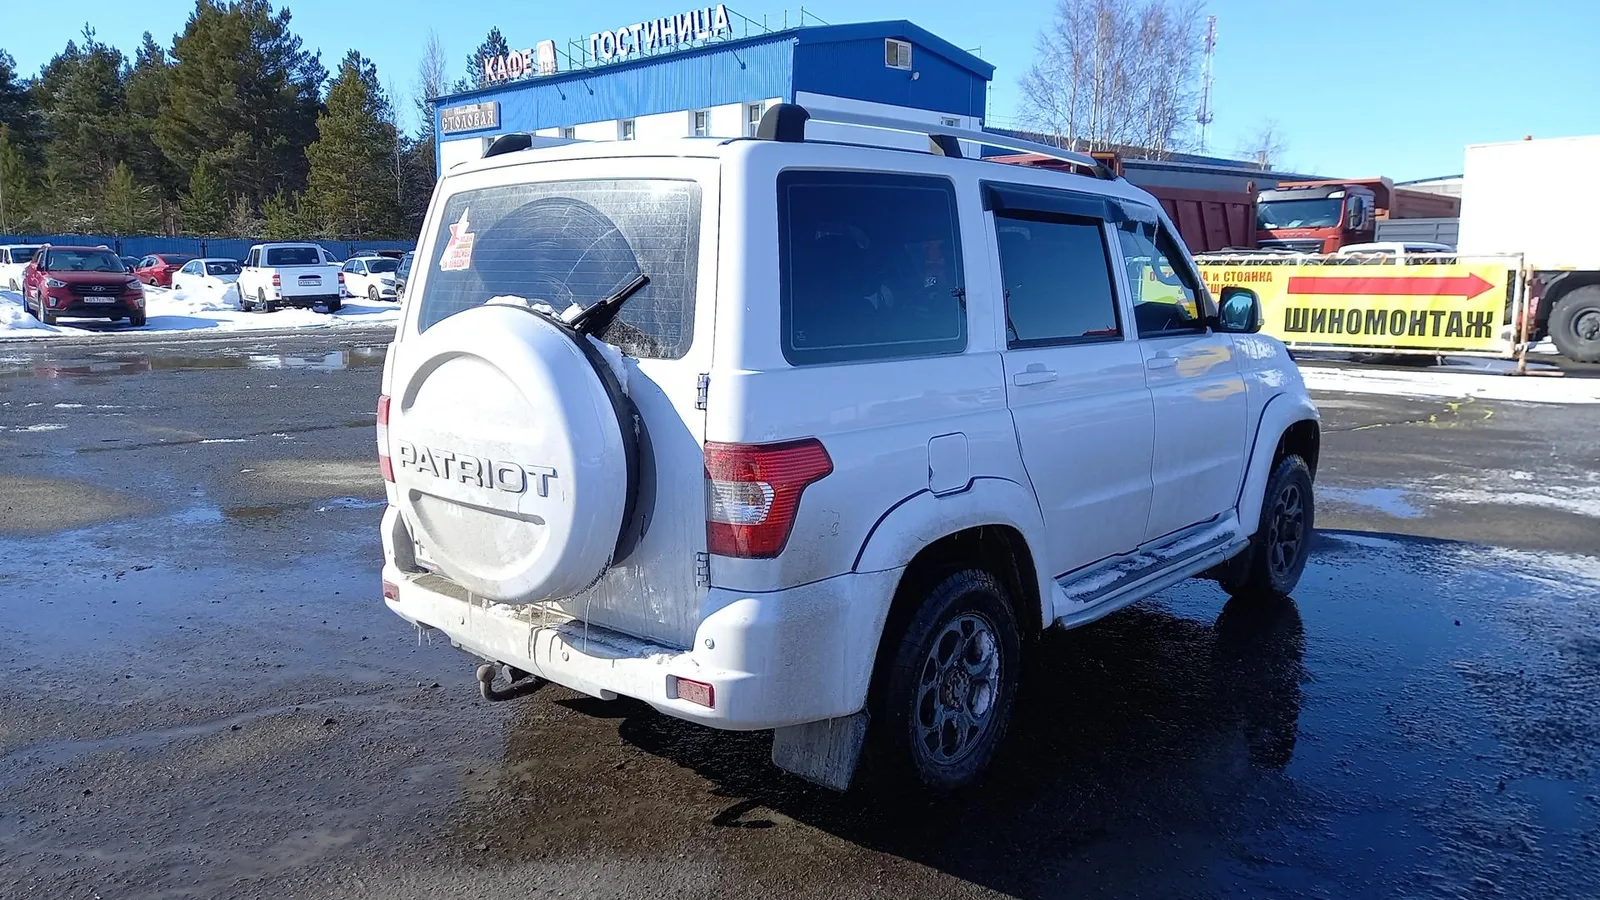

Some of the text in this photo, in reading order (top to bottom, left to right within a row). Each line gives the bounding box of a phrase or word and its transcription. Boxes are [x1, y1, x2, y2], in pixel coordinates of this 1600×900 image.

[590, 4, 732, 62] ГОСТИНИЦА
[484, 48, 534, 82] КАФЕ
[441, 110, 494, 131] СТОЛОВАЯ
[1223, 271, 1273, 283] СТОЯНКА
[1284, 307, 1494, 339] ШИНОМОНТАЖ
[398, 440, 558, 498] PATRIOT
